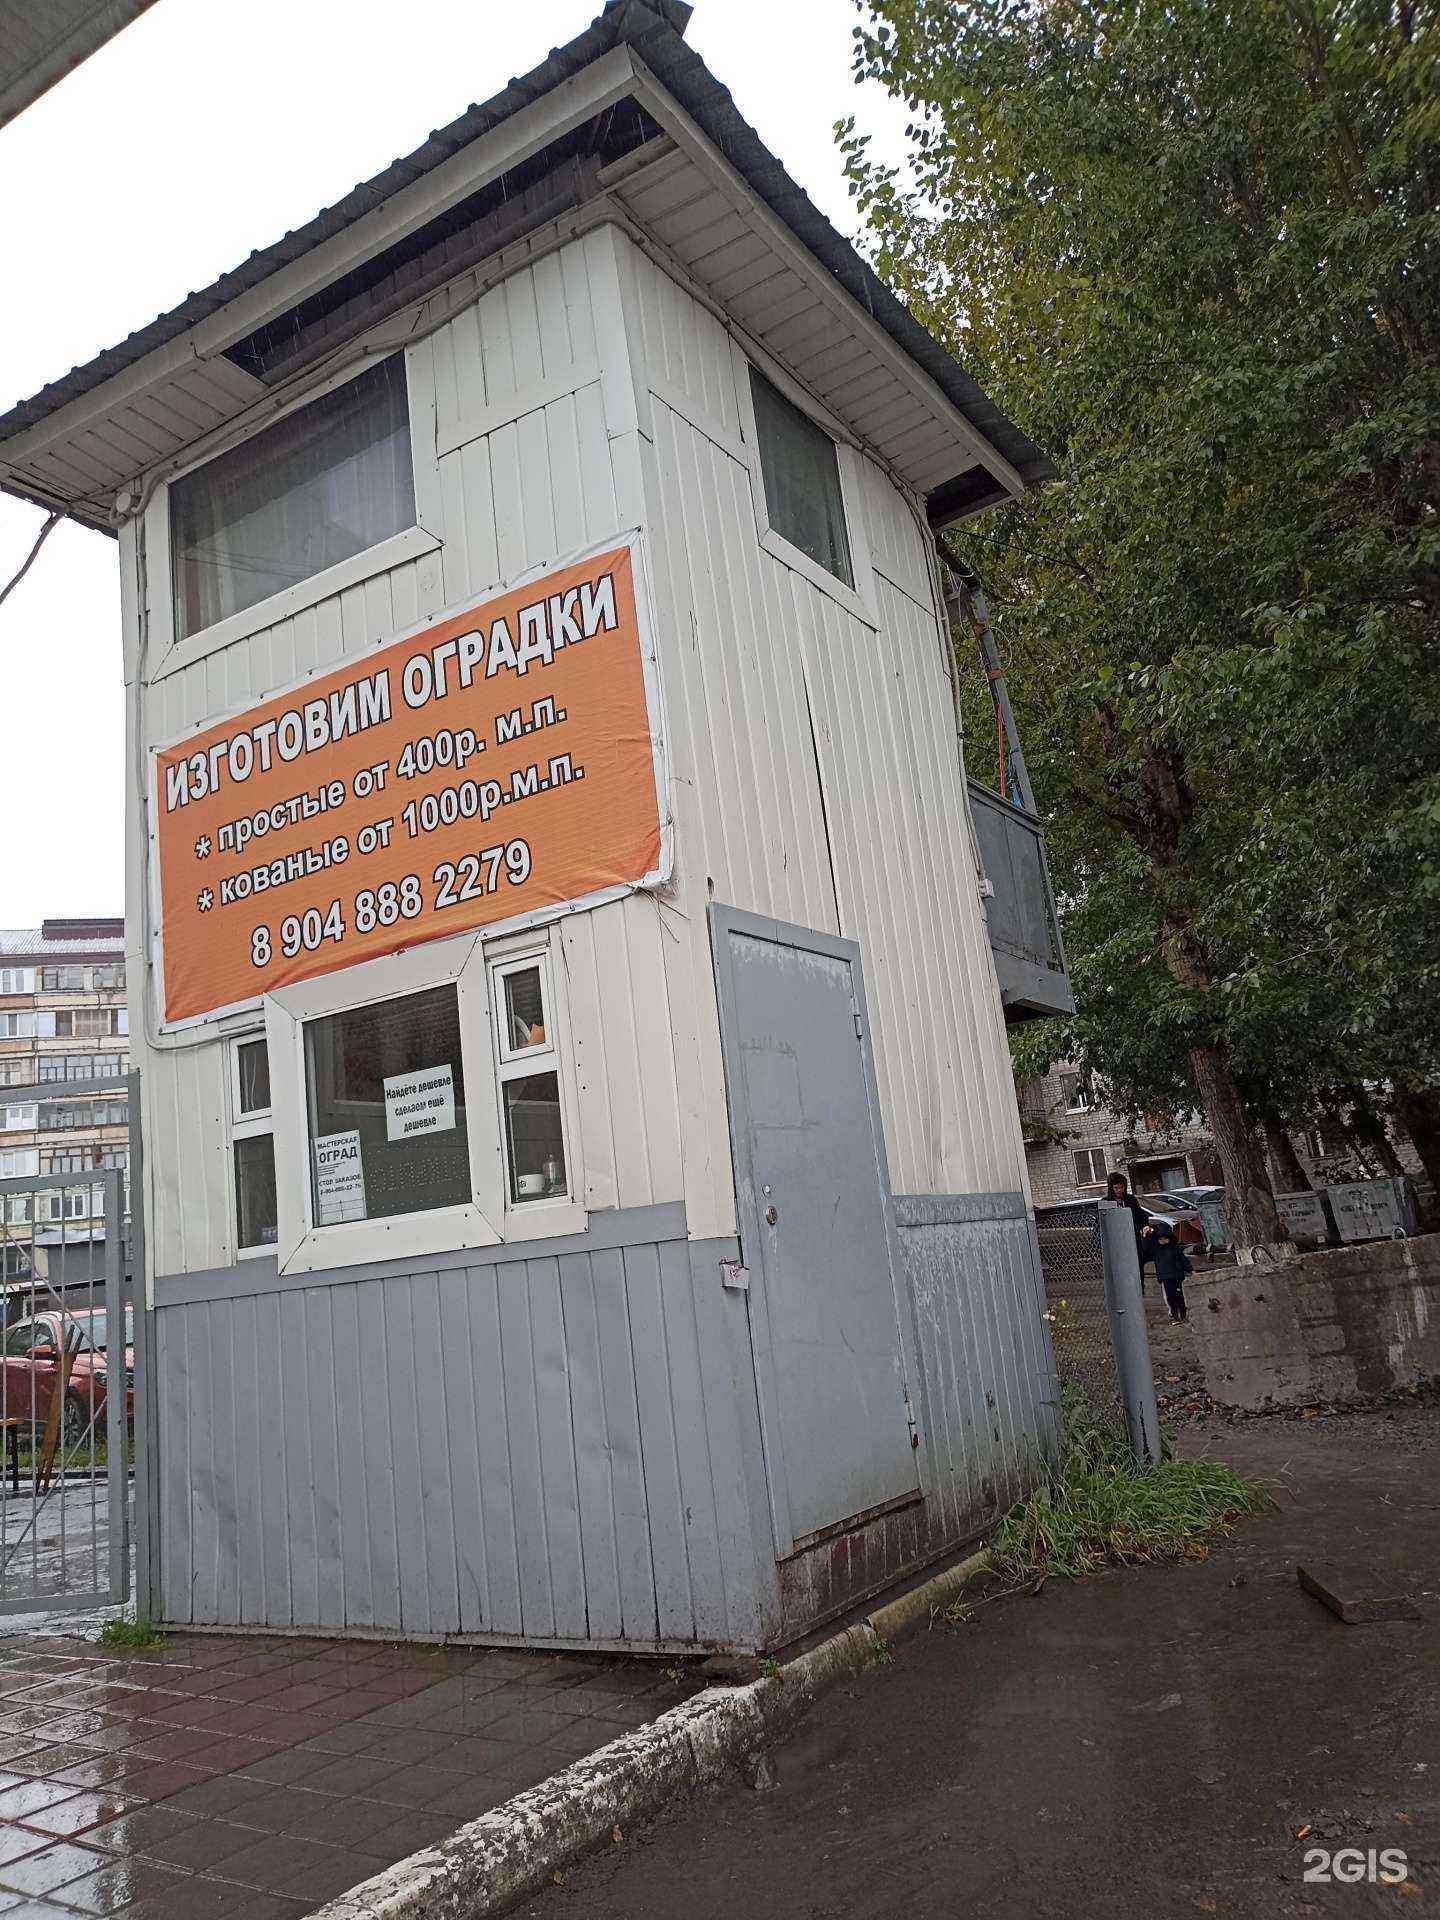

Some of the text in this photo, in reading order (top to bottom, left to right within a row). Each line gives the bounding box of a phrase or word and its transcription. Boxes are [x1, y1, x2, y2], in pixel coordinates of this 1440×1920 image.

[166, 573, 619, 812] ИЗГОТОВИМ ОГРАДКИ
[218, 695, 567, 852] простые от 400р. м.п.
[221, 753, 584, 905] кованые от 1000р.м.п.
[250, 838, 532, 968] 8 904 888 2279
[386, 1076, 452, 1100] Найдёте дешевле
[395, 1101, 427, 1117] сделаем
[404, 1116, 437, 1133] дешевле
[319, 1146, 358, 1163] ОГРАД
